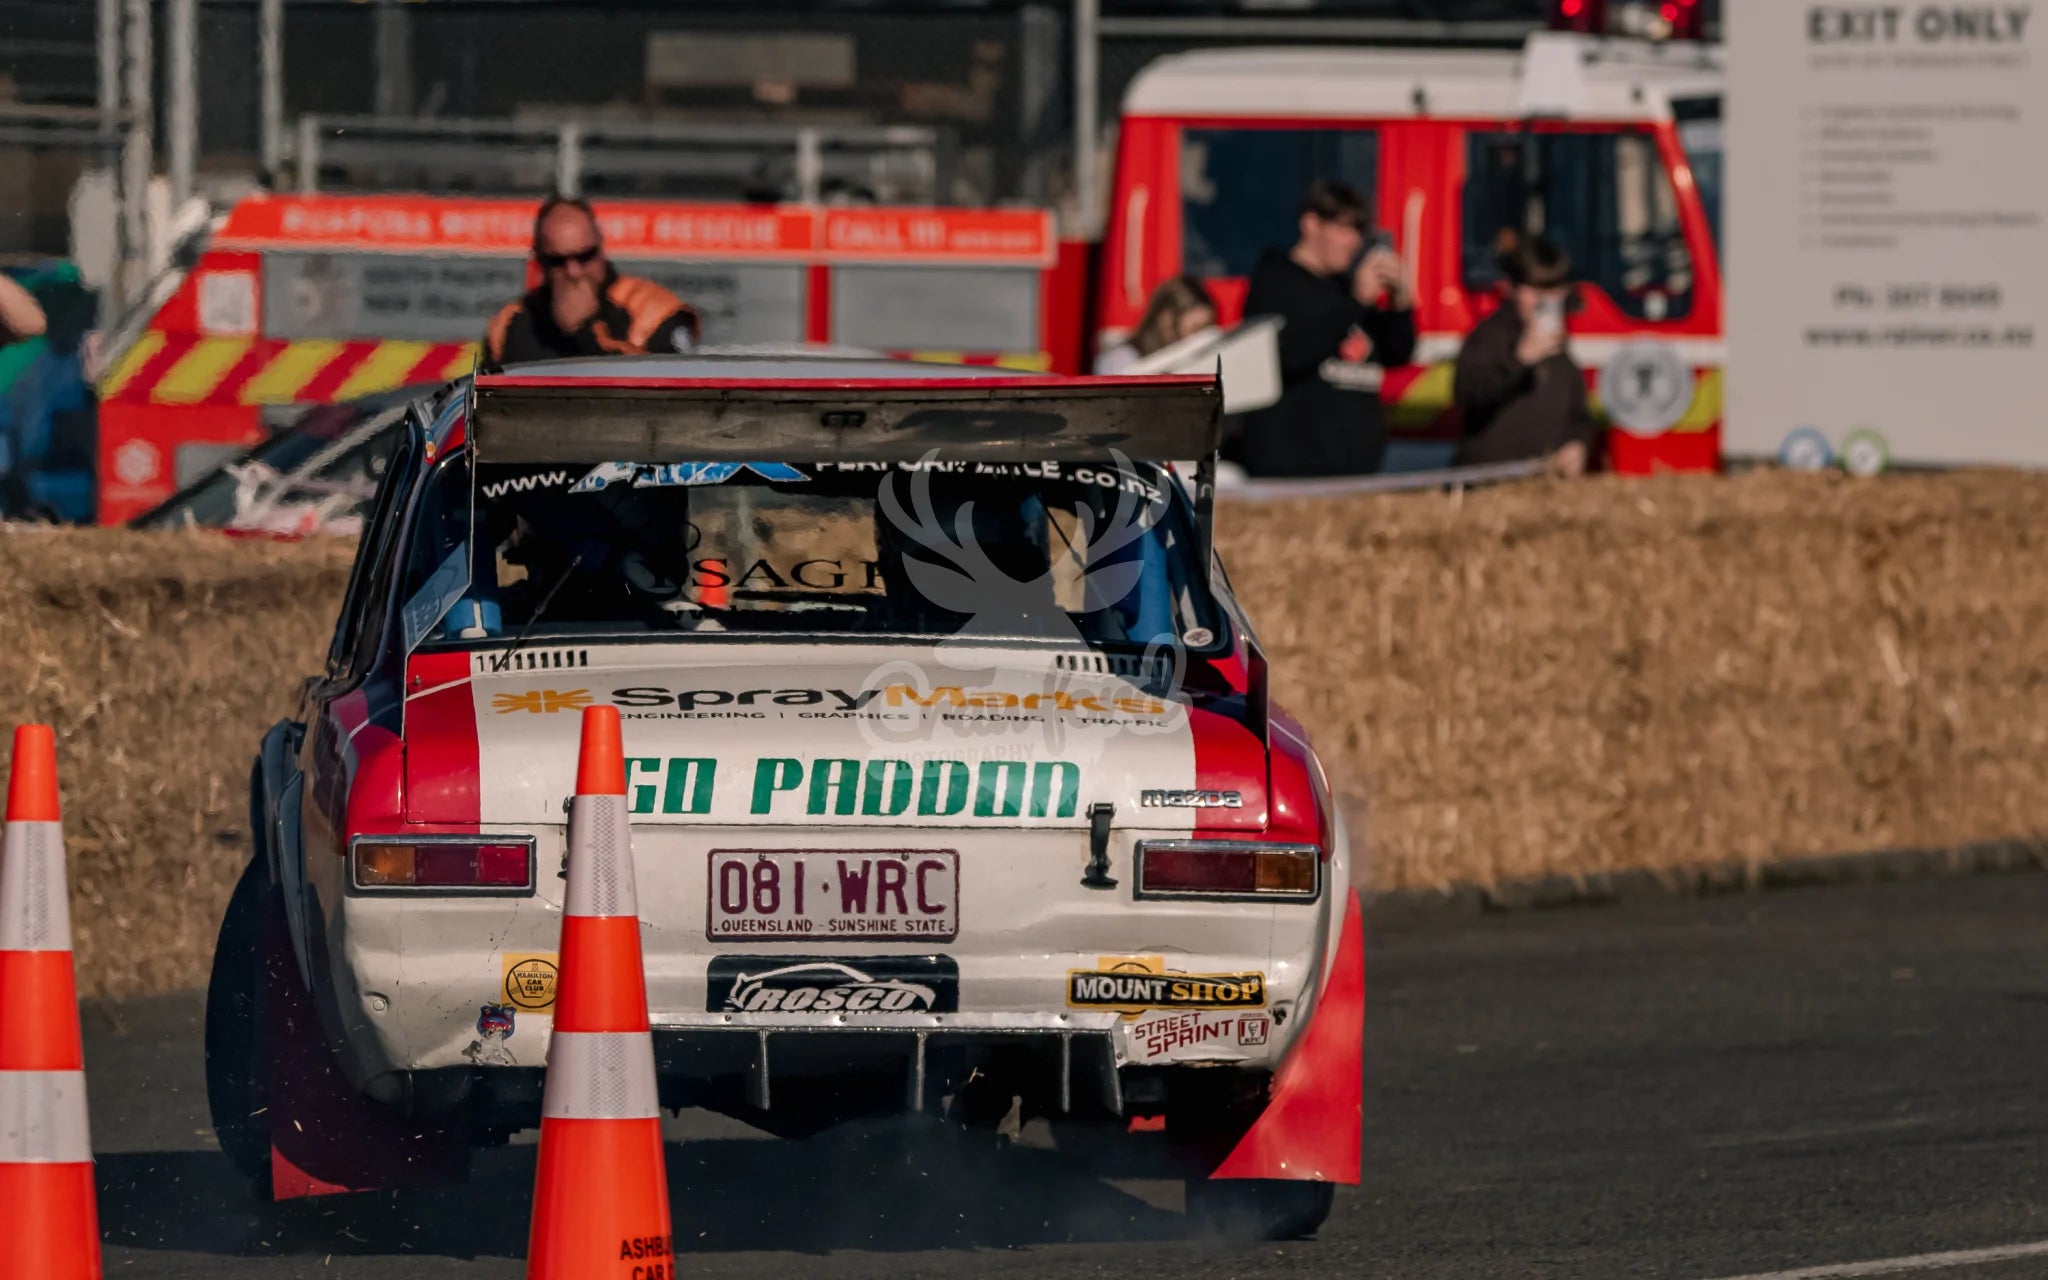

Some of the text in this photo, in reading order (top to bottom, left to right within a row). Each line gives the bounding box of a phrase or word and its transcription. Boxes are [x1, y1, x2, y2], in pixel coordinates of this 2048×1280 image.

[1806, 6, 2030, 43] EXIT ONLY
[653, 213, 776, 244] RESCUE
[482, 470, 575, 498] www.
[611, 684, 1166, 715] SprayMarks
[620, 711, 1170, 728] ENGINEERING GRAPHICS ROADING TRAFFIC
[750, 757, 1081, 819] PADDON
[1141, 789, 1243, 809] mazda
[720, 860, 947, 914] 081 WRC
[721, 918, 945, 932] QUEENSLAND SUNSHINE STATE
[745, 987, 917, 1011] ROSCO
[1076, 976, 1260, 1001] MOUNT SHOP
[1135, 1012, 1202, 1040] STREET
[1147, 1019, 1235, 1058] SPRINT
